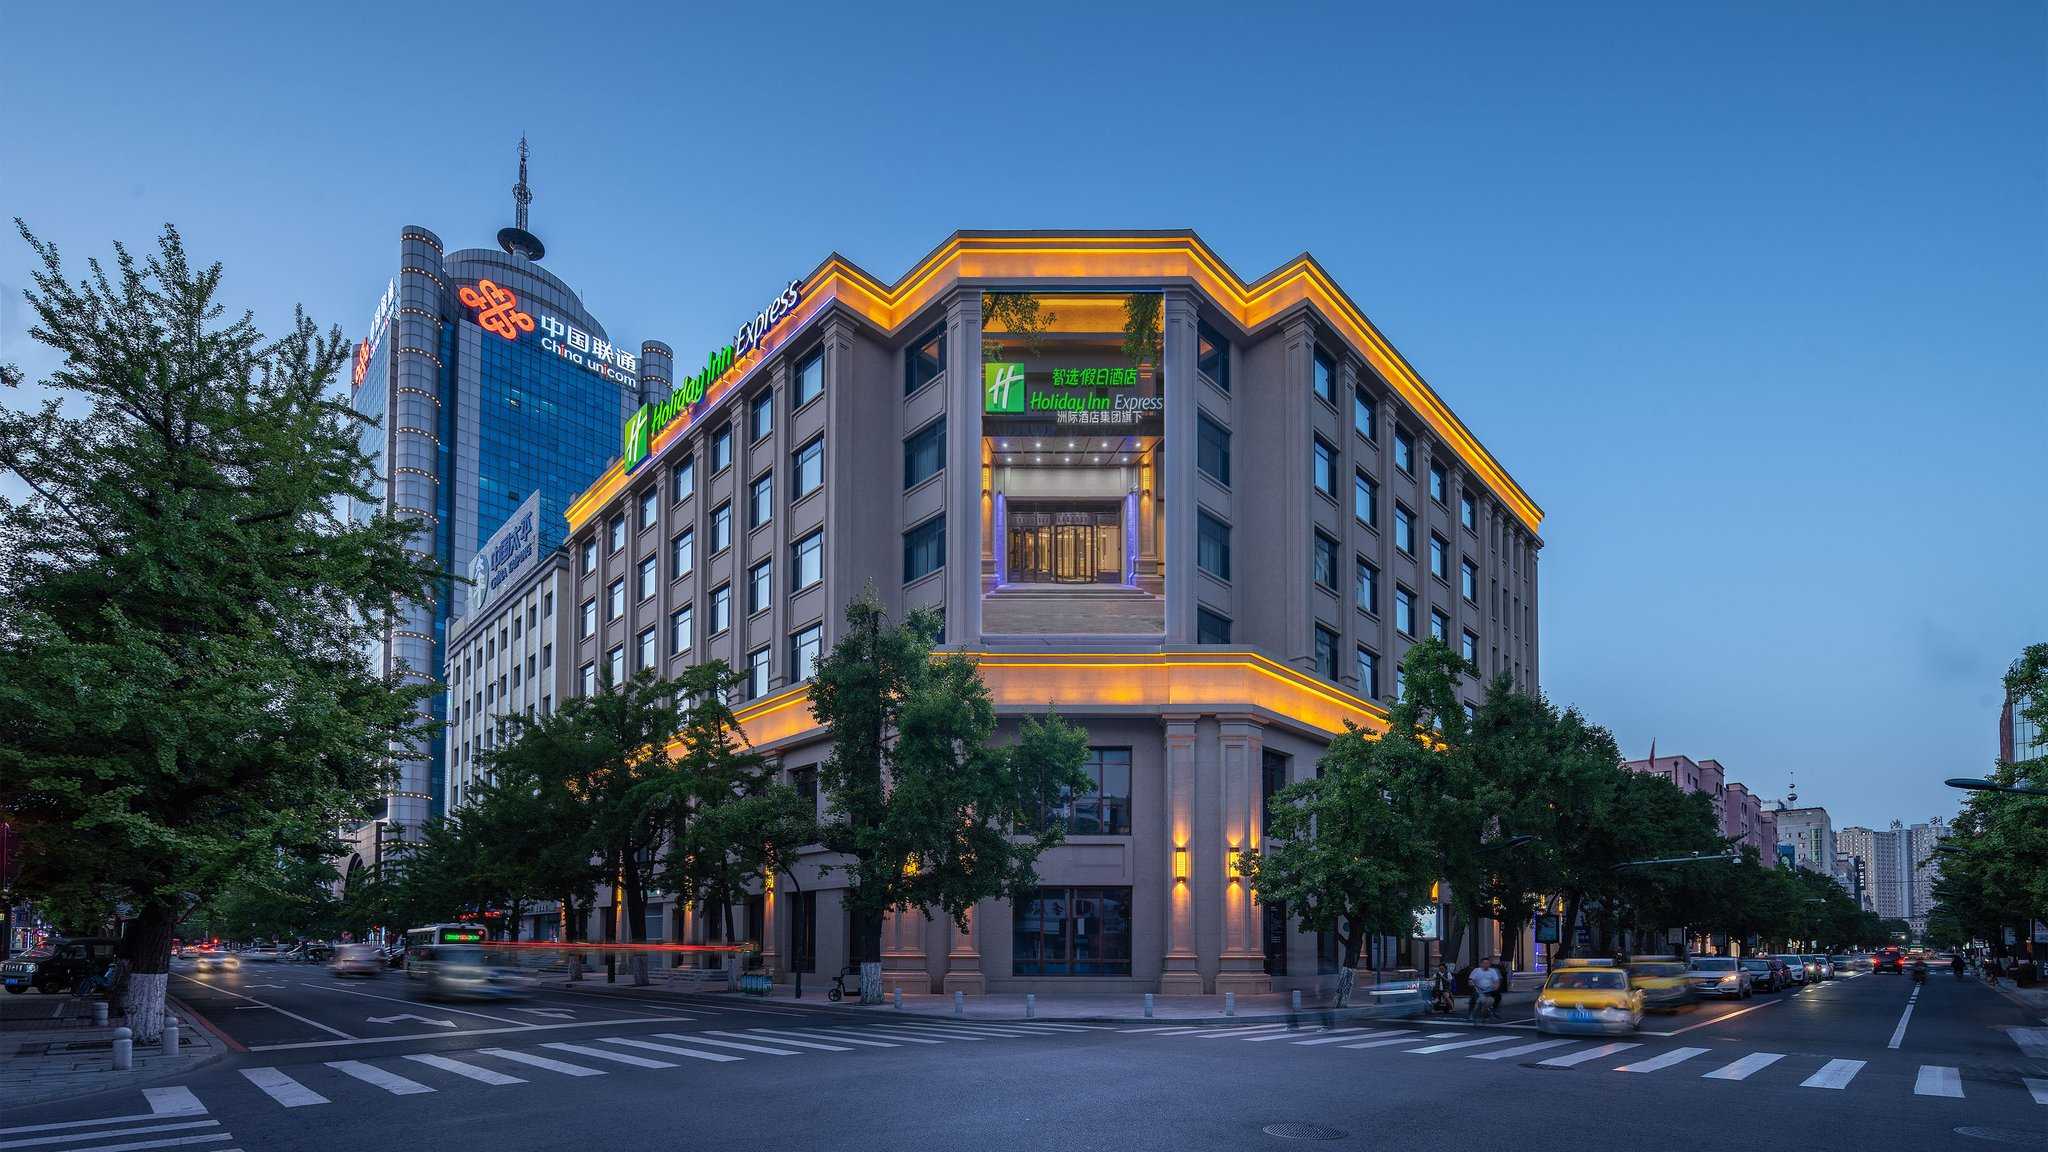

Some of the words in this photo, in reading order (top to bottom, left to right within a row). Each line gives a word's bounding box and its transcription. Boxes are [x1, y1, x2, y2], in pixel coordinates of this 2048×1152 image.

[541, 315, 636, 374] 中国联通
[541, 337, 582, 365] China
[587, 359, 636, 388] unicom
[651, 367, 706, 436] Holiday
[707, 345, 735, 385] Inn
[736, 280, 799, 356] Express
[1051, 367, 1137, 386] 智选假日酒店
[1030, 391, 1086, 413] Holiday
[1087, 391, 1111, 410] Inn
[1114, 394, 1164, 412] Express
[1056, 410, 1143, 424] 洲际酒店集团旗下
